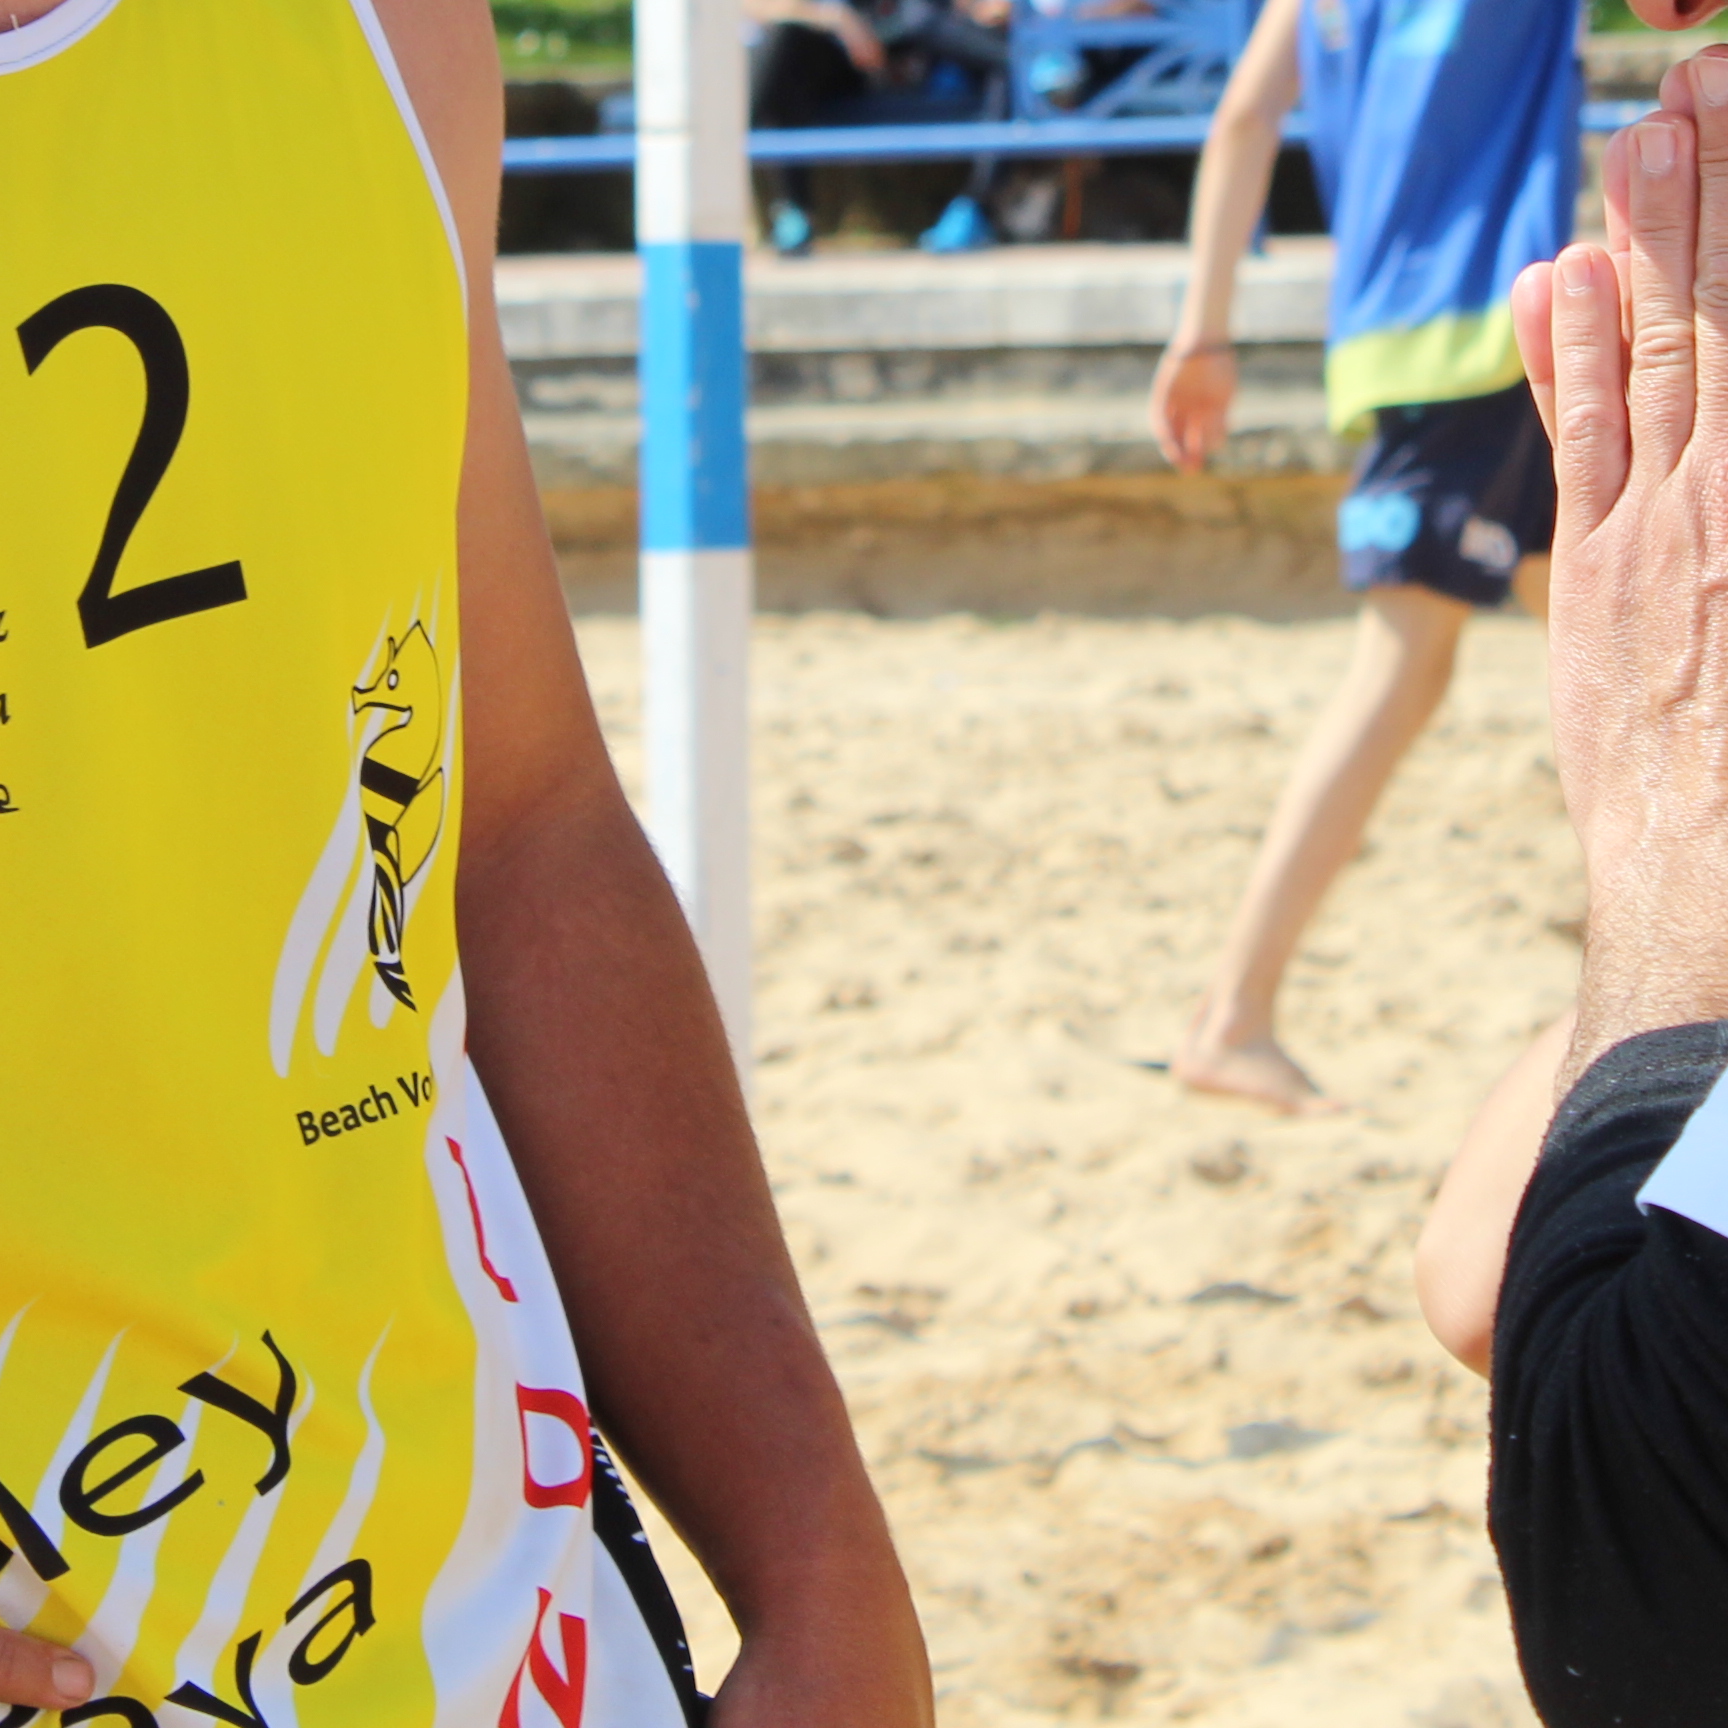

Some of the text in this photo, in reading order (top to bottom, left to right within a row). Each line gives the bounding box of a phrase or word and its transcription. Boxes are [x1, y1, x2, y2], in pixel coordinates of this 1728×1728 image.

[17, 284, 247, 648] 2
[295, 1061, 435, 1147] Beach Vo
